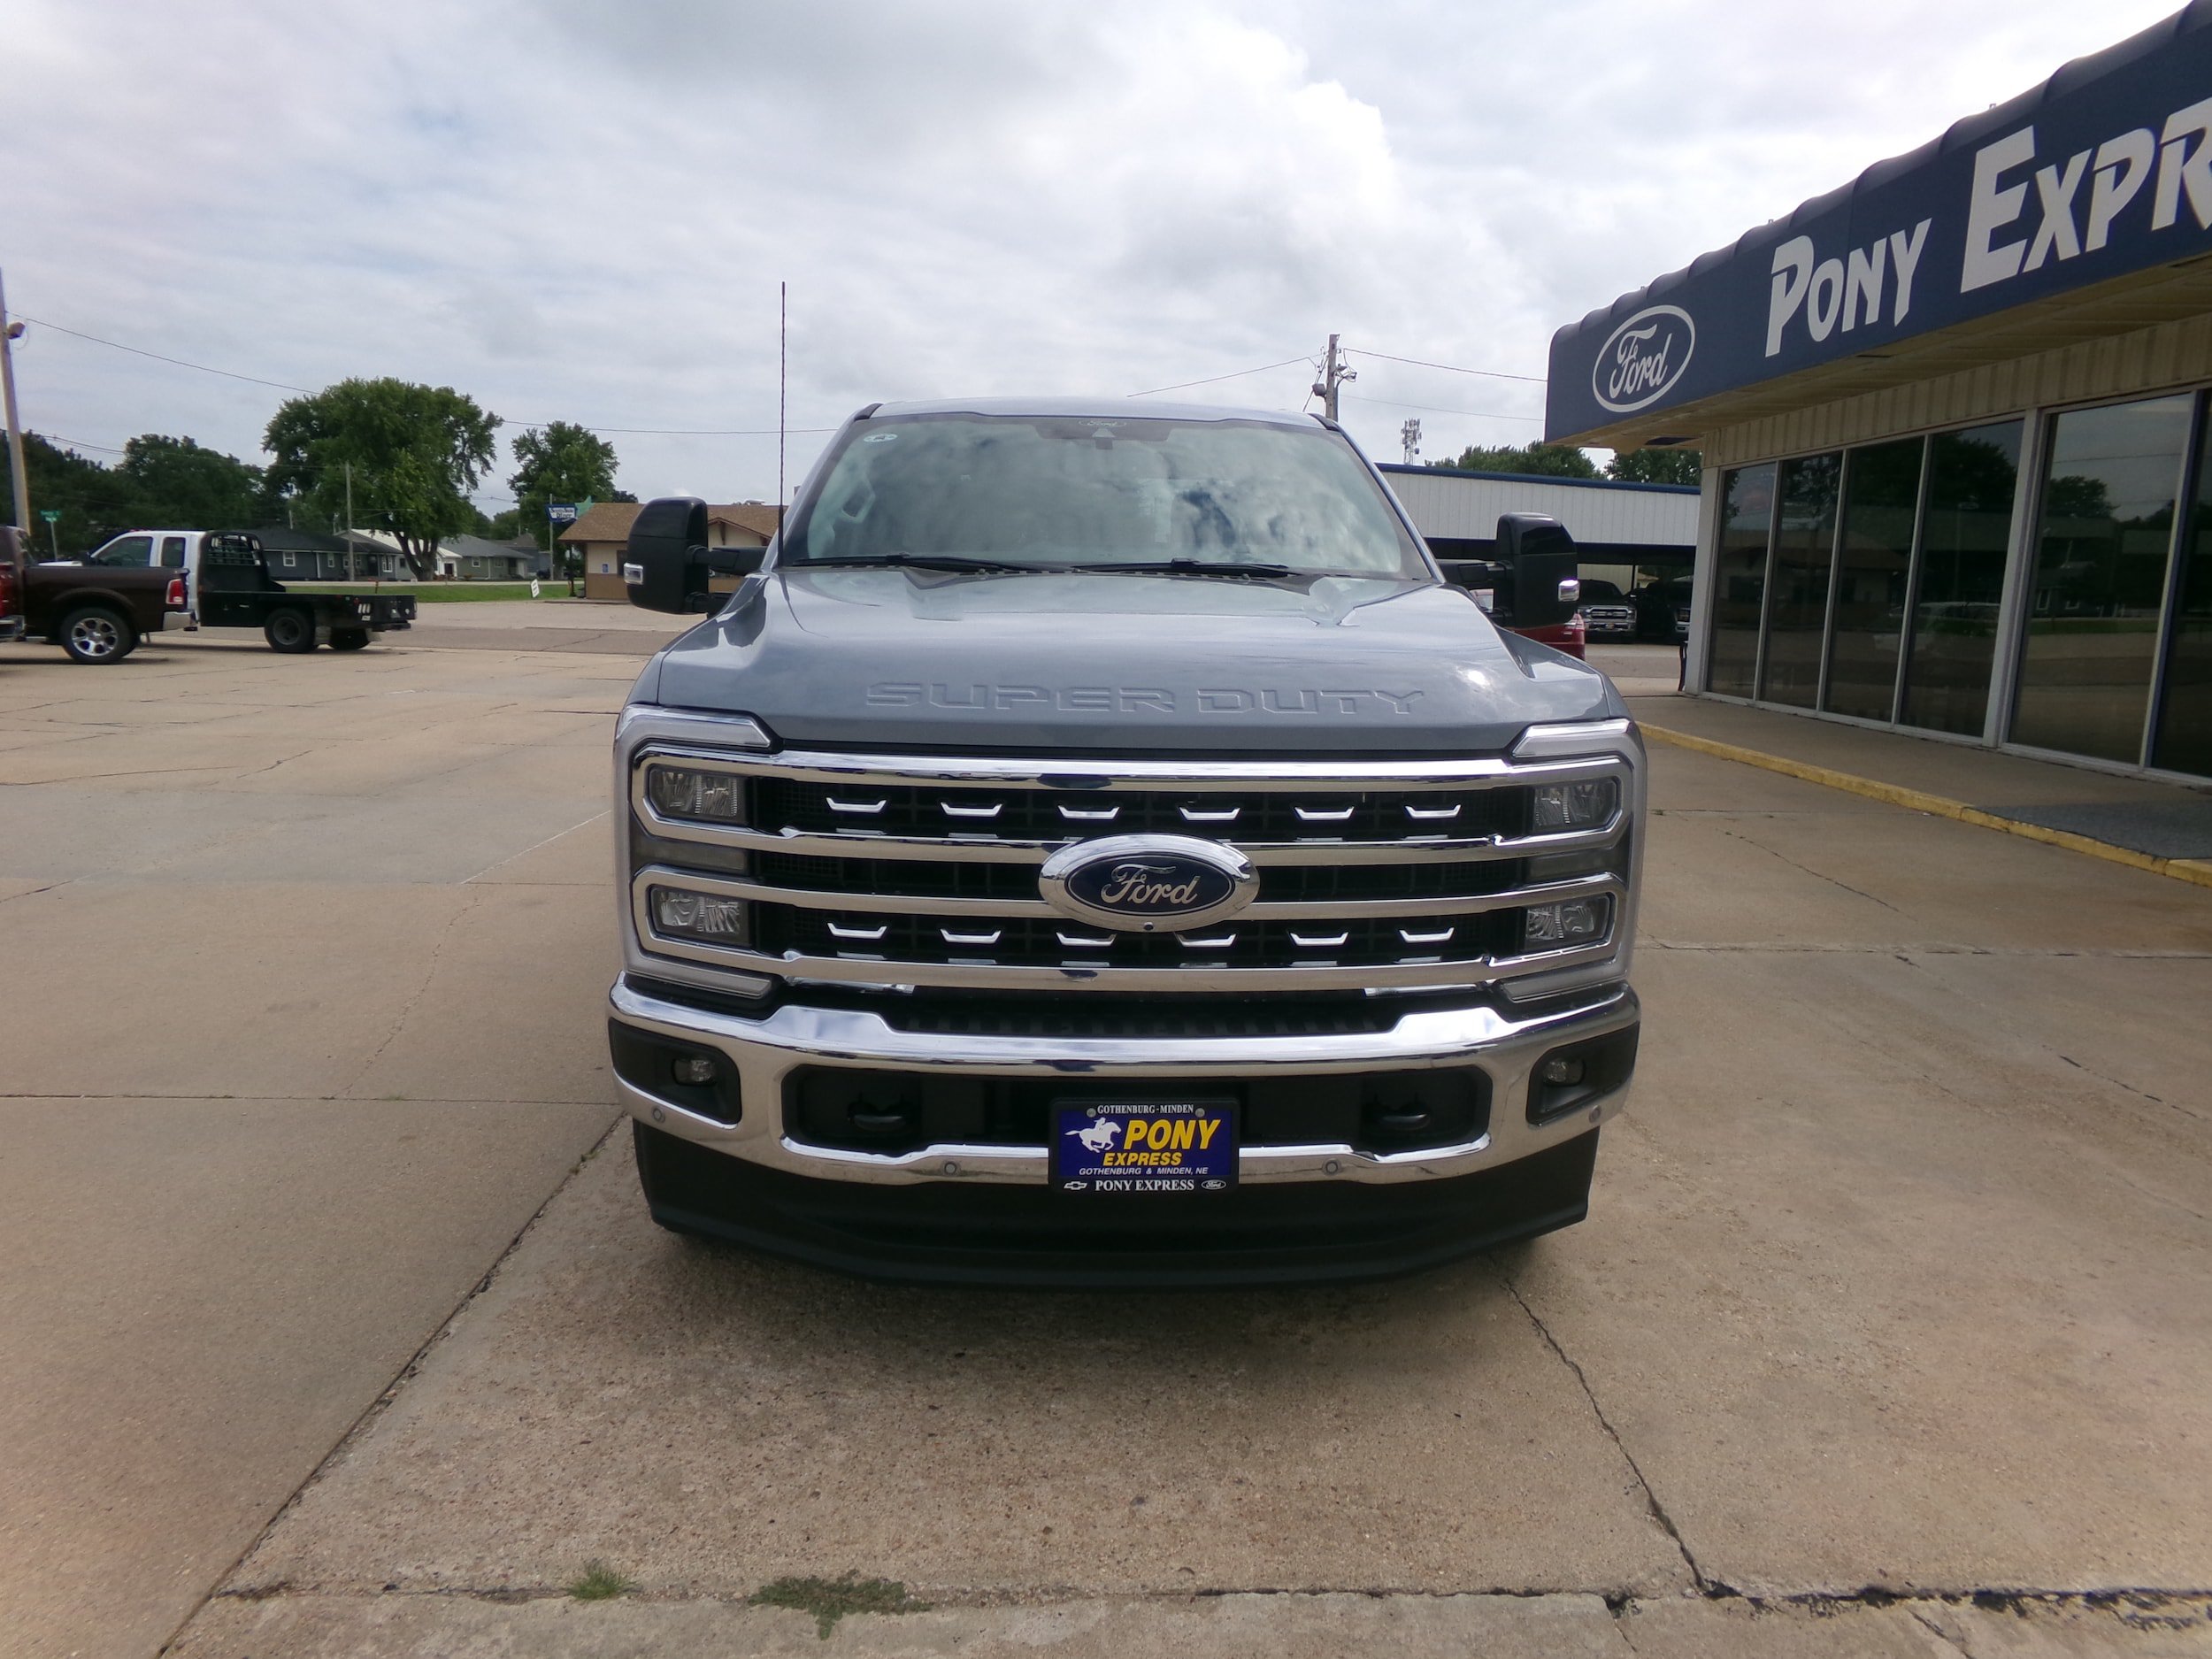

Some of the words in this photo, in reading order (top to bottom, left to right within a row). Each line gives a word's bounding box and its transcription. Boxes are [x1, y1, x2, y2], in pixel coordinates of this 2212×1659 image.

[1764, 217, 1932, 358] PONY
[1609, 323, 1673, 399] Ford
[865, 682, 1175, 713] SUPER
[1197, 687, 1425, 716] DUTY
[1100, 864, 1202, 904] Ford
[1123, 1118, 1222, 1150] PONY
[1079, 1167, 1142, 1176] GOTHENBURG
[1156, 1167, 1194, 1176] MINDEN,
[1195, 1166, 1210, 1175] NE
[1102, 1152, 1183, 1166] EXPRESS
[1094, 1179, 1133, 1191] PONY
[1135, 1179, 1195, 1191] EXPRESS
